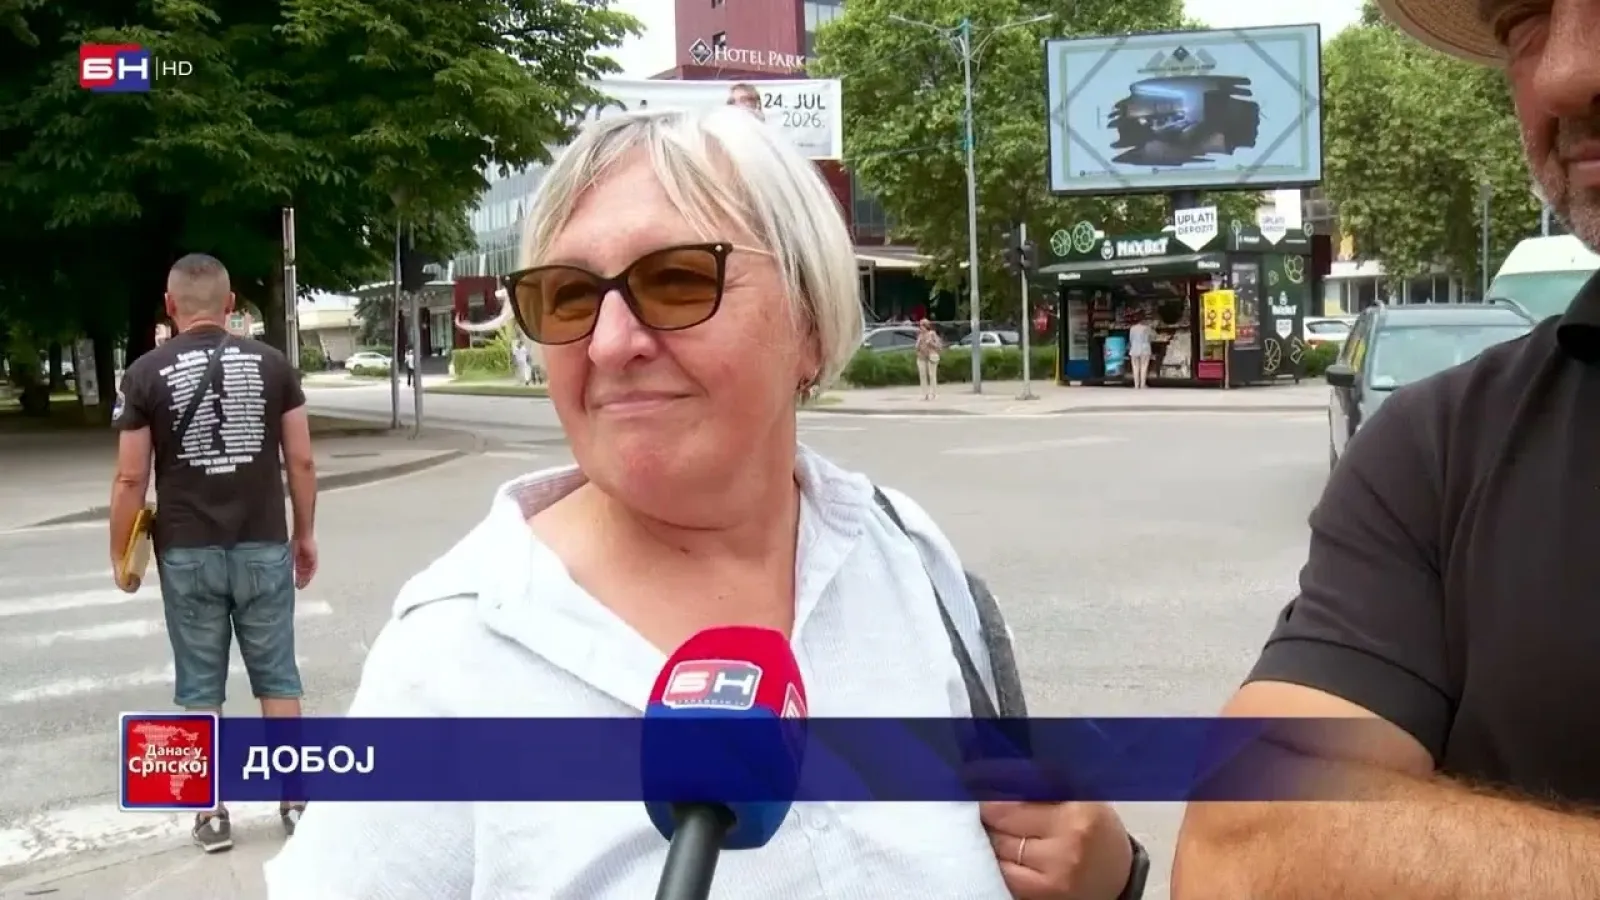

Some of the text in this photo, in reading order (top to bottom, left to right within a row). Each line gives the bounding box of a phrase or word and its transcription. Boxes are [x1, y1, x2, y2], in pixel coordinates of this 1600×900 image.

[714, 44, 805, 67] HOTEL PARK
[764, 92, 826, 110] 24. JUL
[782, 111, 825, 128] 2026.
[1177, 213, 1214, 225] UPLATI
[1178, 224, 1213, 235] DEPOZIT
